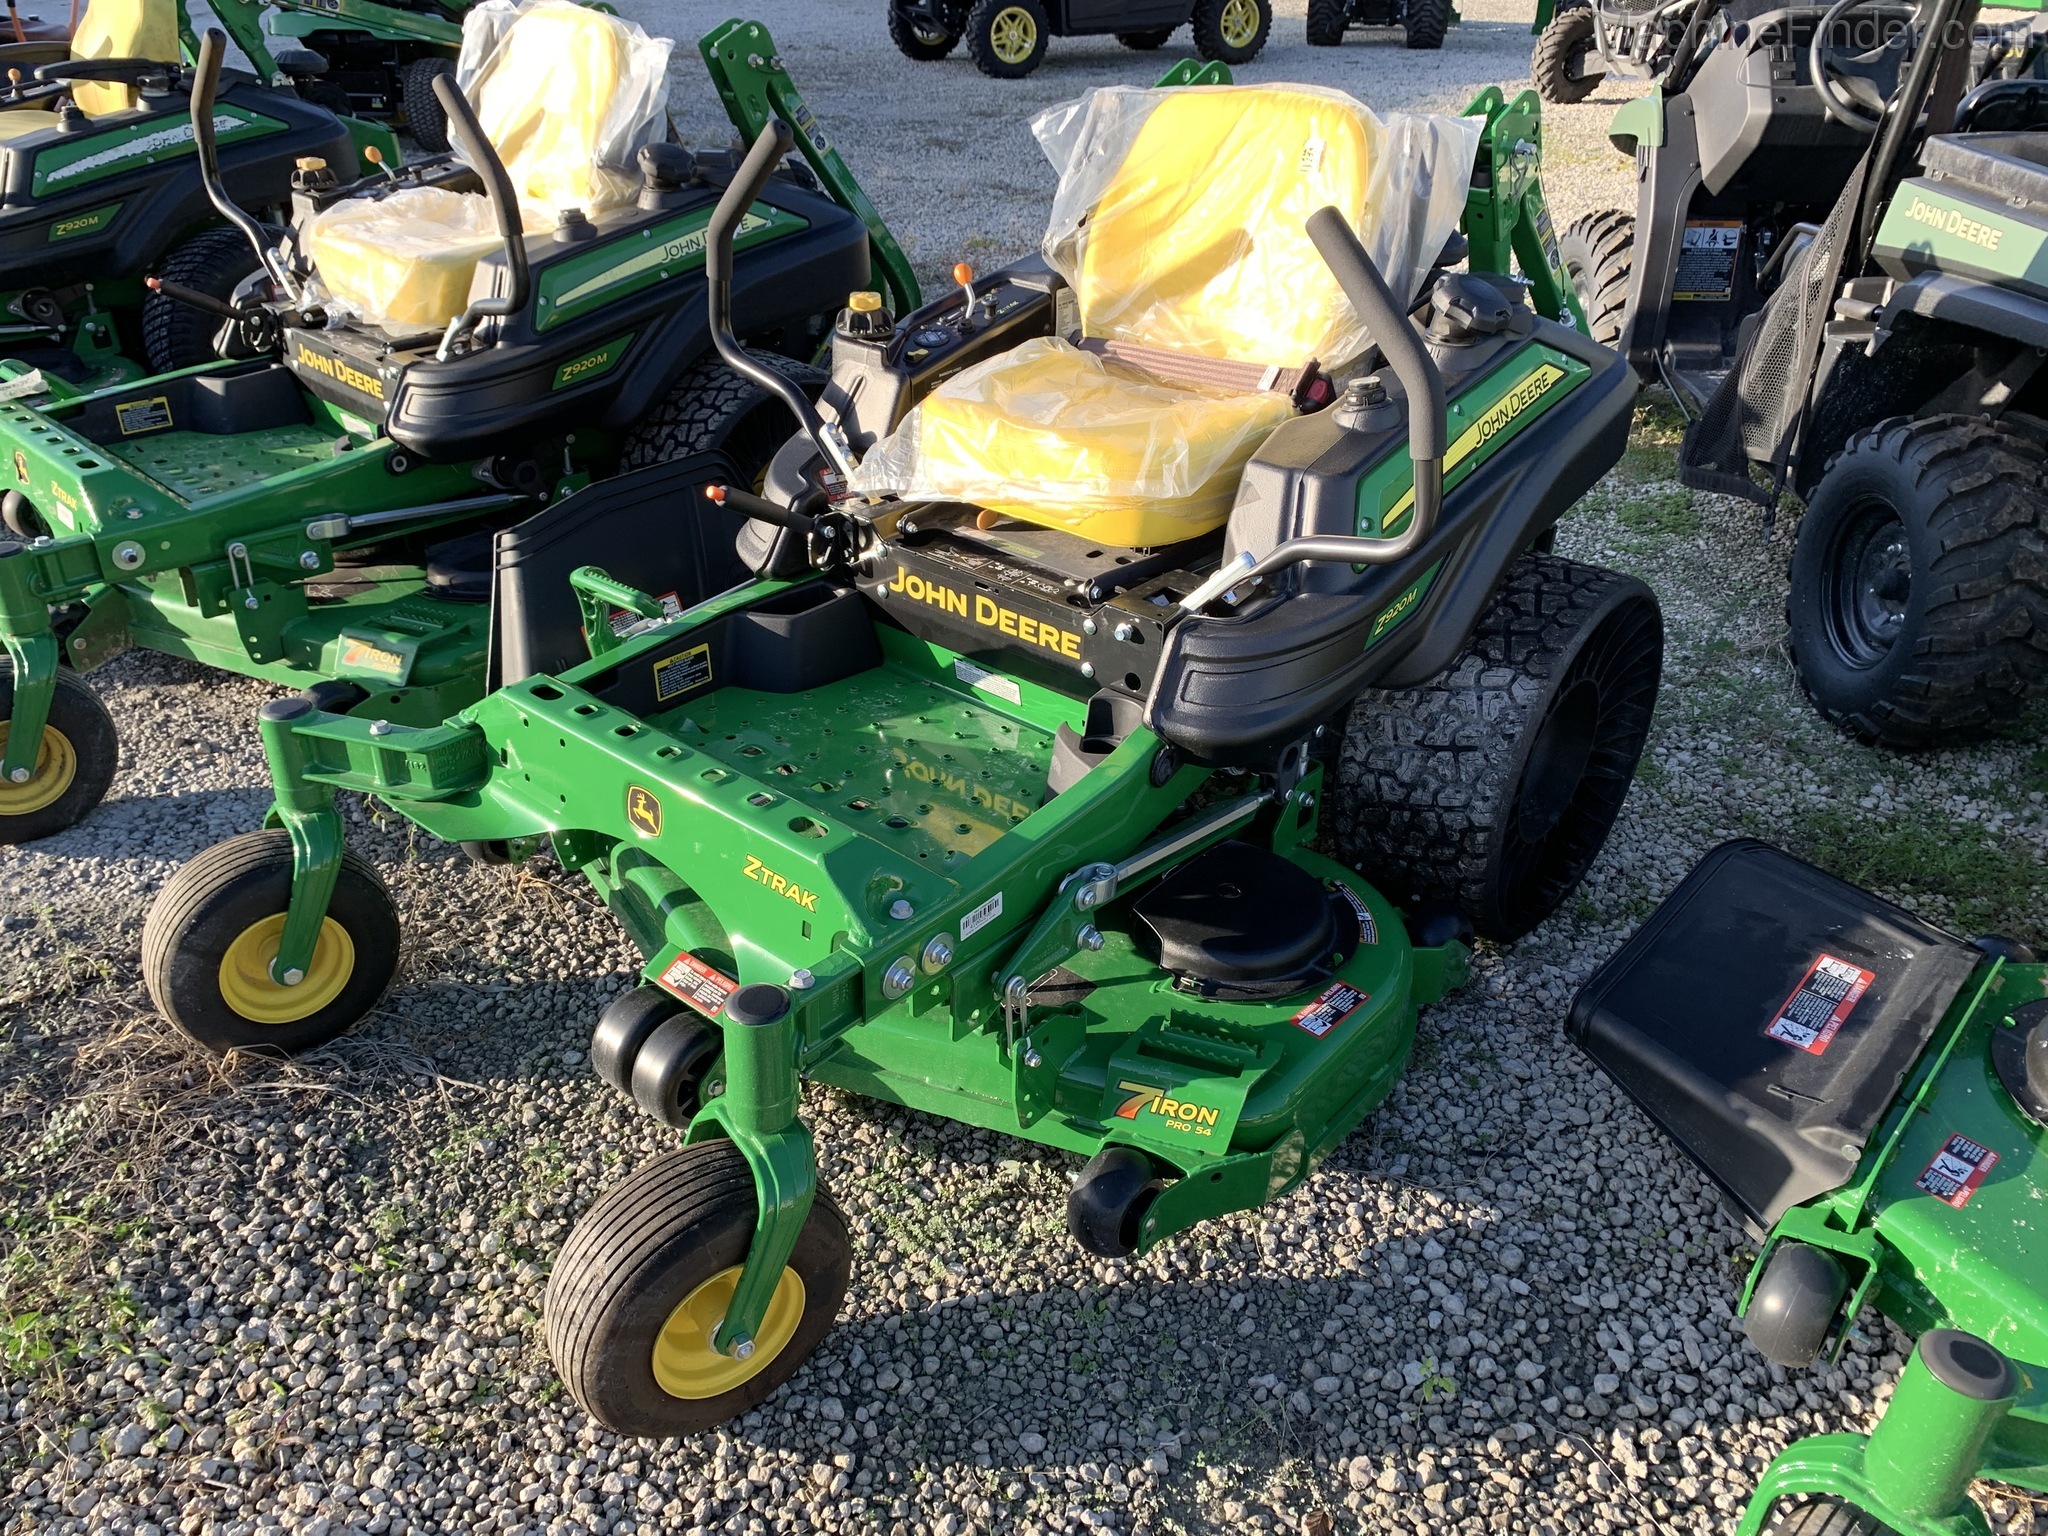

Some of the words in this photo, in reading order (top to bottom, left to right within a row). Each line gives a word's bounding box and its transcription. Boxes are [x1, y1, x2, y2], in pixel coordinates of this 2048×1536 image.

[56, 215, 99, 235] Z920M
[661, 233, 701, 262] JOHN
[1904, 195, 1948, 230] JOHN
[1945, 208, 2004, 252] DEERE
[297, 342, 335, 378] JOHN
[333, 358, 385, 400] DEERE
[561, 352, 608, 381] Z920M
[1475, 403, 1511, 447] JOHN
[1509, 371, 1551, 416] DEERE
[889, 565, 968, 618] JOHN
[974, 594, 1082, 661] DEERE
[1374, 587, 1418, 636] Z920M
[742, 853, 820, 914] ZTRAK
[1149, 1095, 1220, 1127] IRON
[1165, 1119, 1192, 1132] PRO
[1194, 1126, 1212, 1136] 54
